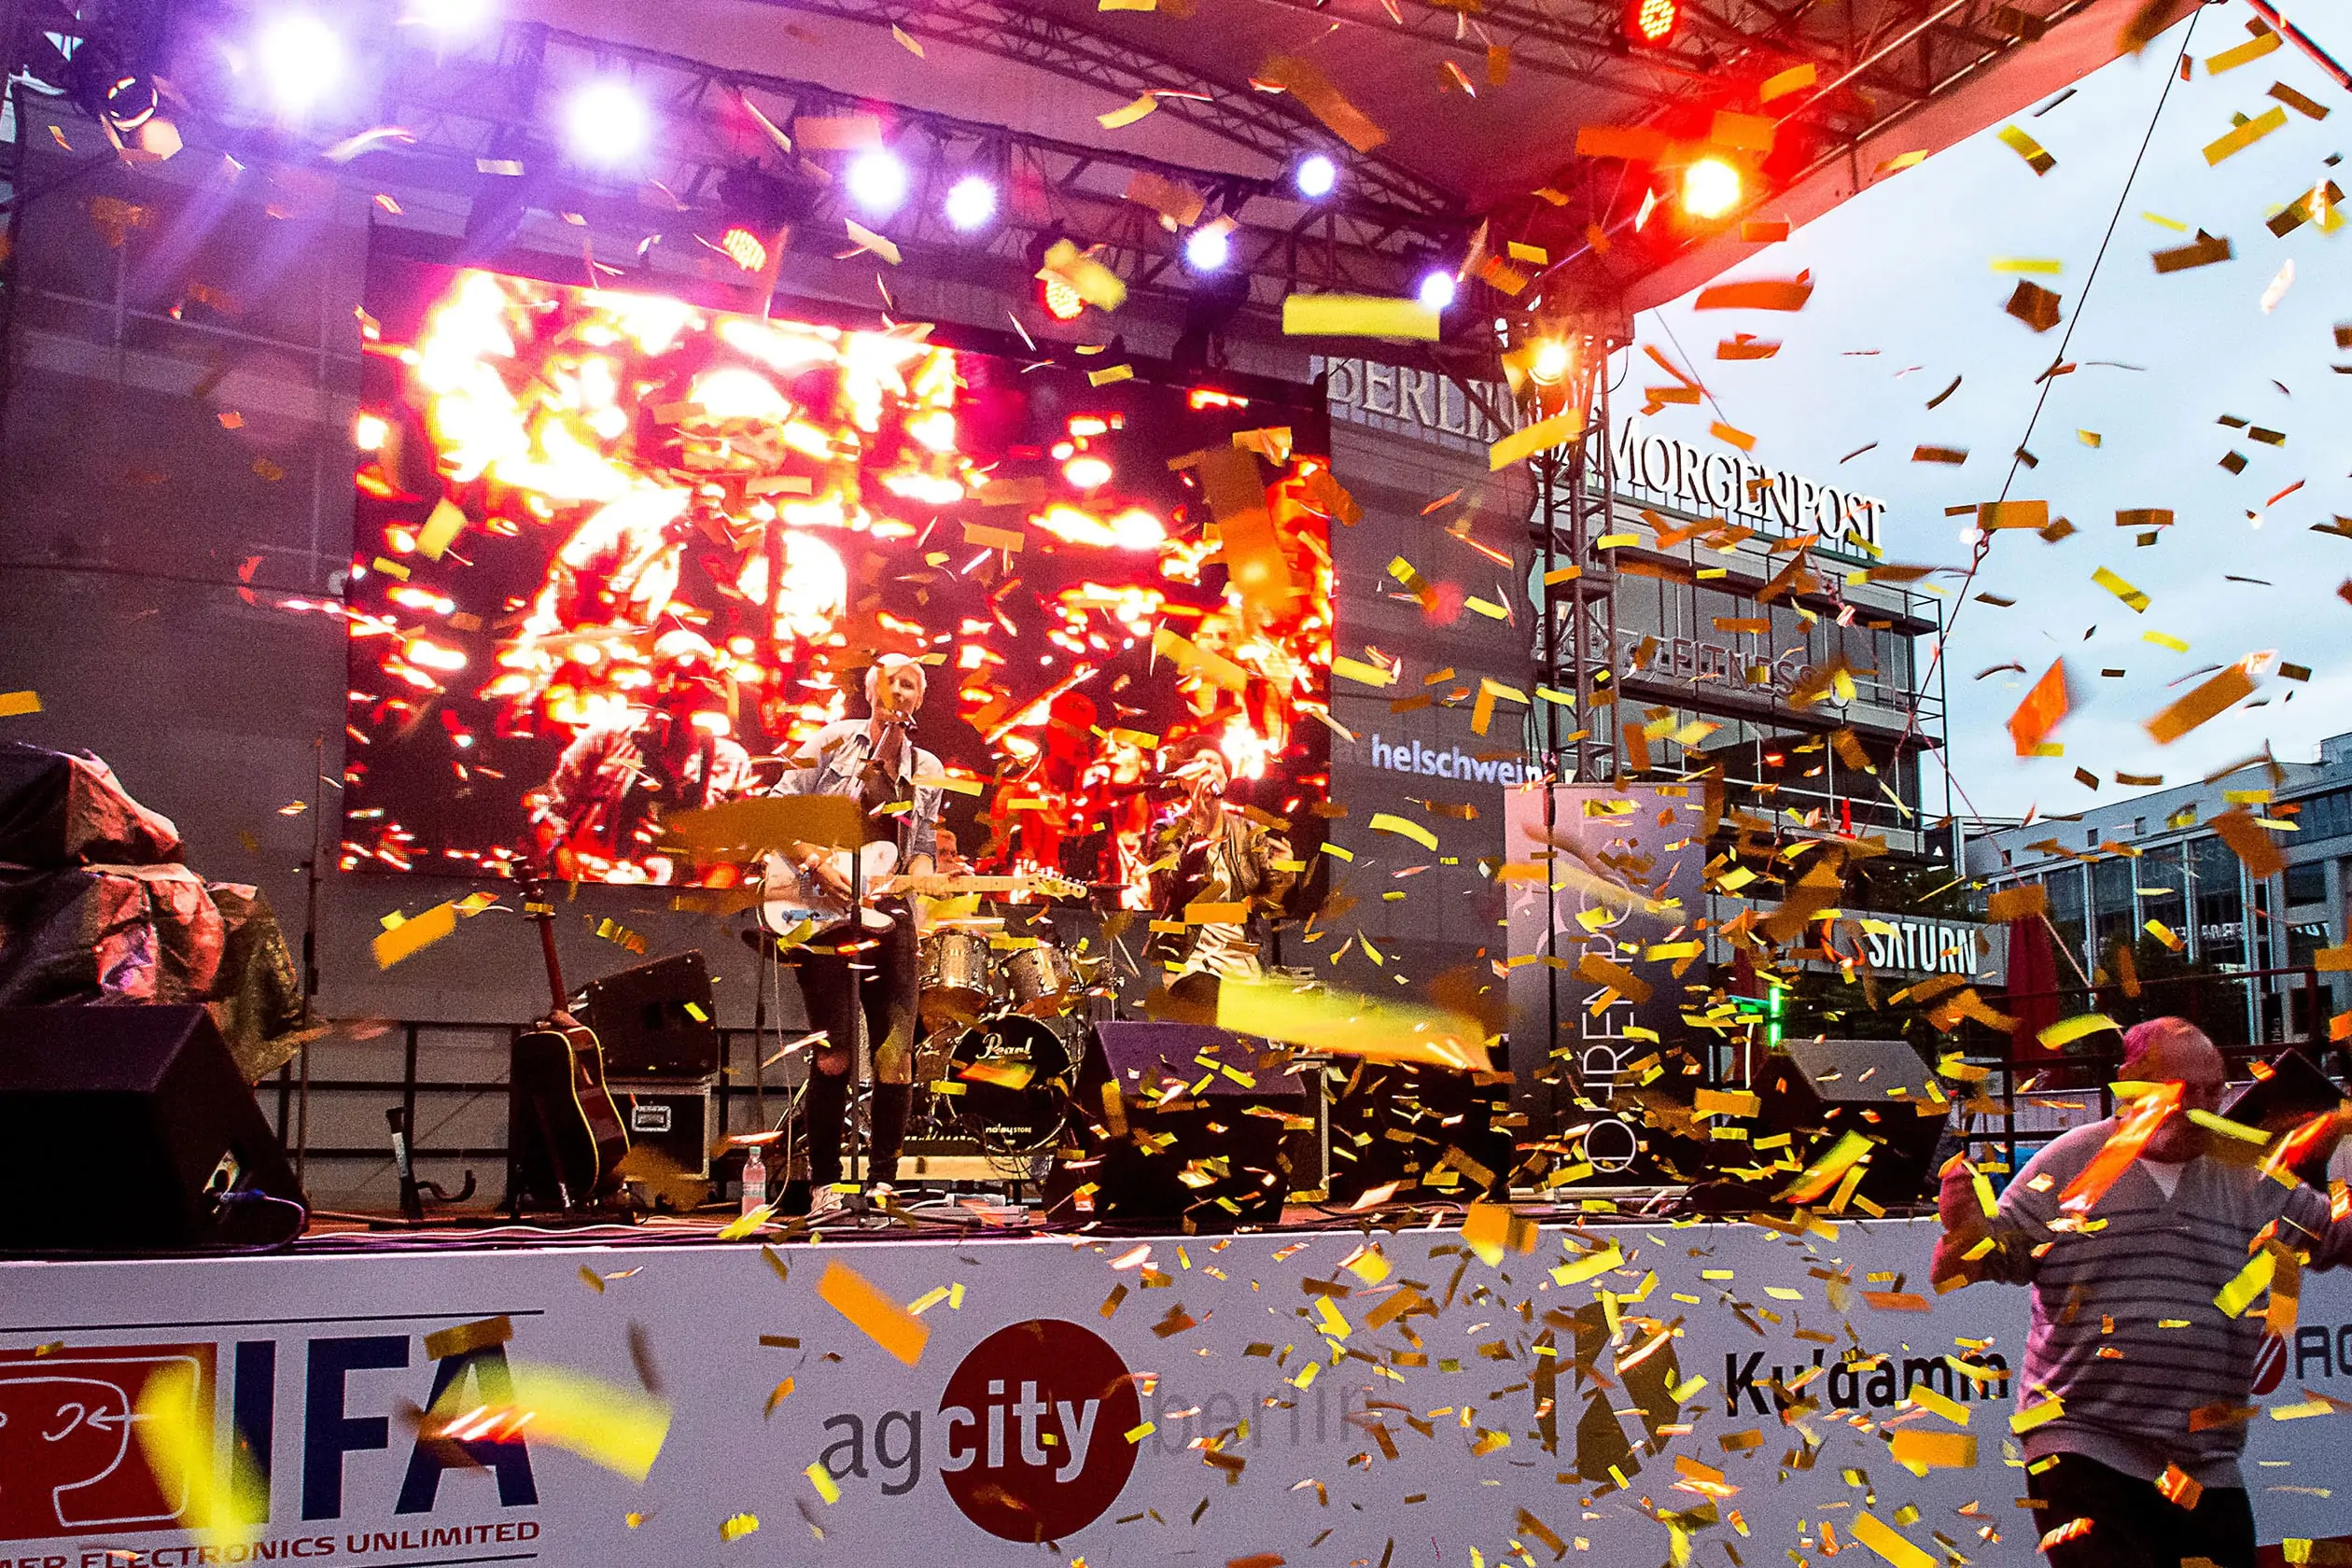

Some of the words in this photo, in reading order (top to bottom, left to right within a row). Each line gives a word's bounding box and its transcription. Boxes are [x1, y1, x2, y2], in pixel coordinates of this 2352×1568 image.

[1593, 408, 1886, 552] MORGENPOST
[1868, 919, 1977, 974] SATURN
[975, 1032, 1033, 1059] Pearl
[1726, 1348, 2009, 1417] Ku'damm
[231, 1334, 539, 1523] IFA
[346, 1521, 540, 1553] UNLIMITED
